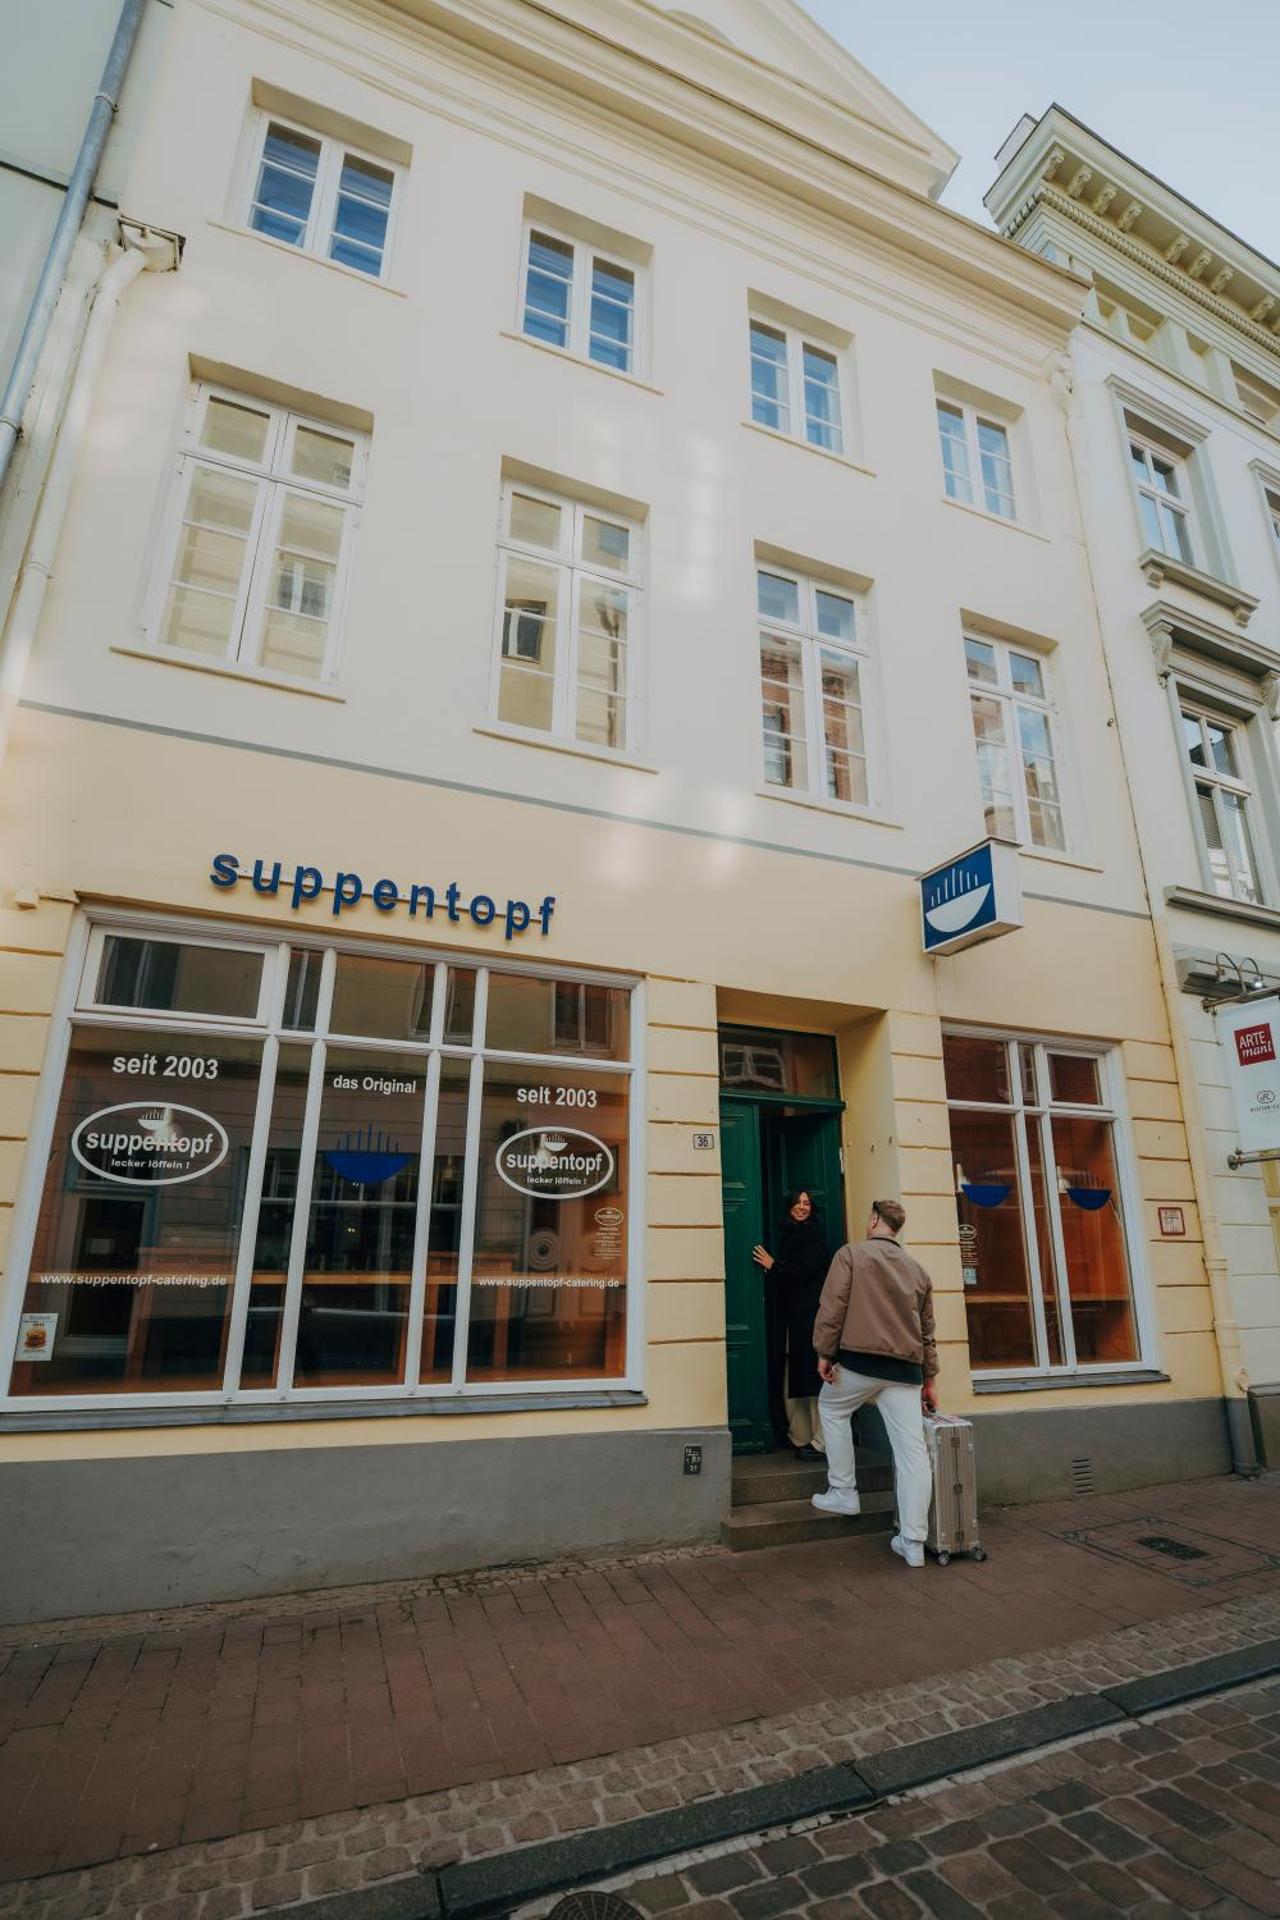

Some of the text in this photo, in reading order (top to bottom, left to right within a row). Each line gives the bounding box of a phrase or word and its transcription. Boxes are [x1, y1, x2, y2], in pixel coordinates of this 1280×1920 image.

[210, 853, 555, 940] suppentopf
[1239, 1031, 1266, 1049] ARTE
[112, 1053, 219, 1080] seit 2003
[333, 1075, 416, 1095] das Original
[516, 1086, 598, 1108] seit 2003
[85, 1132, 214, 1159] suppentopf
[110, 1158, 147, 1168] lecker
[506, 1152, 603, 1176] suppentopf
[40, 1273, 228, 1288] www.suppentopf-catering.de
[479, 1278, 620, 1289] www.suppentopf-catering.de
